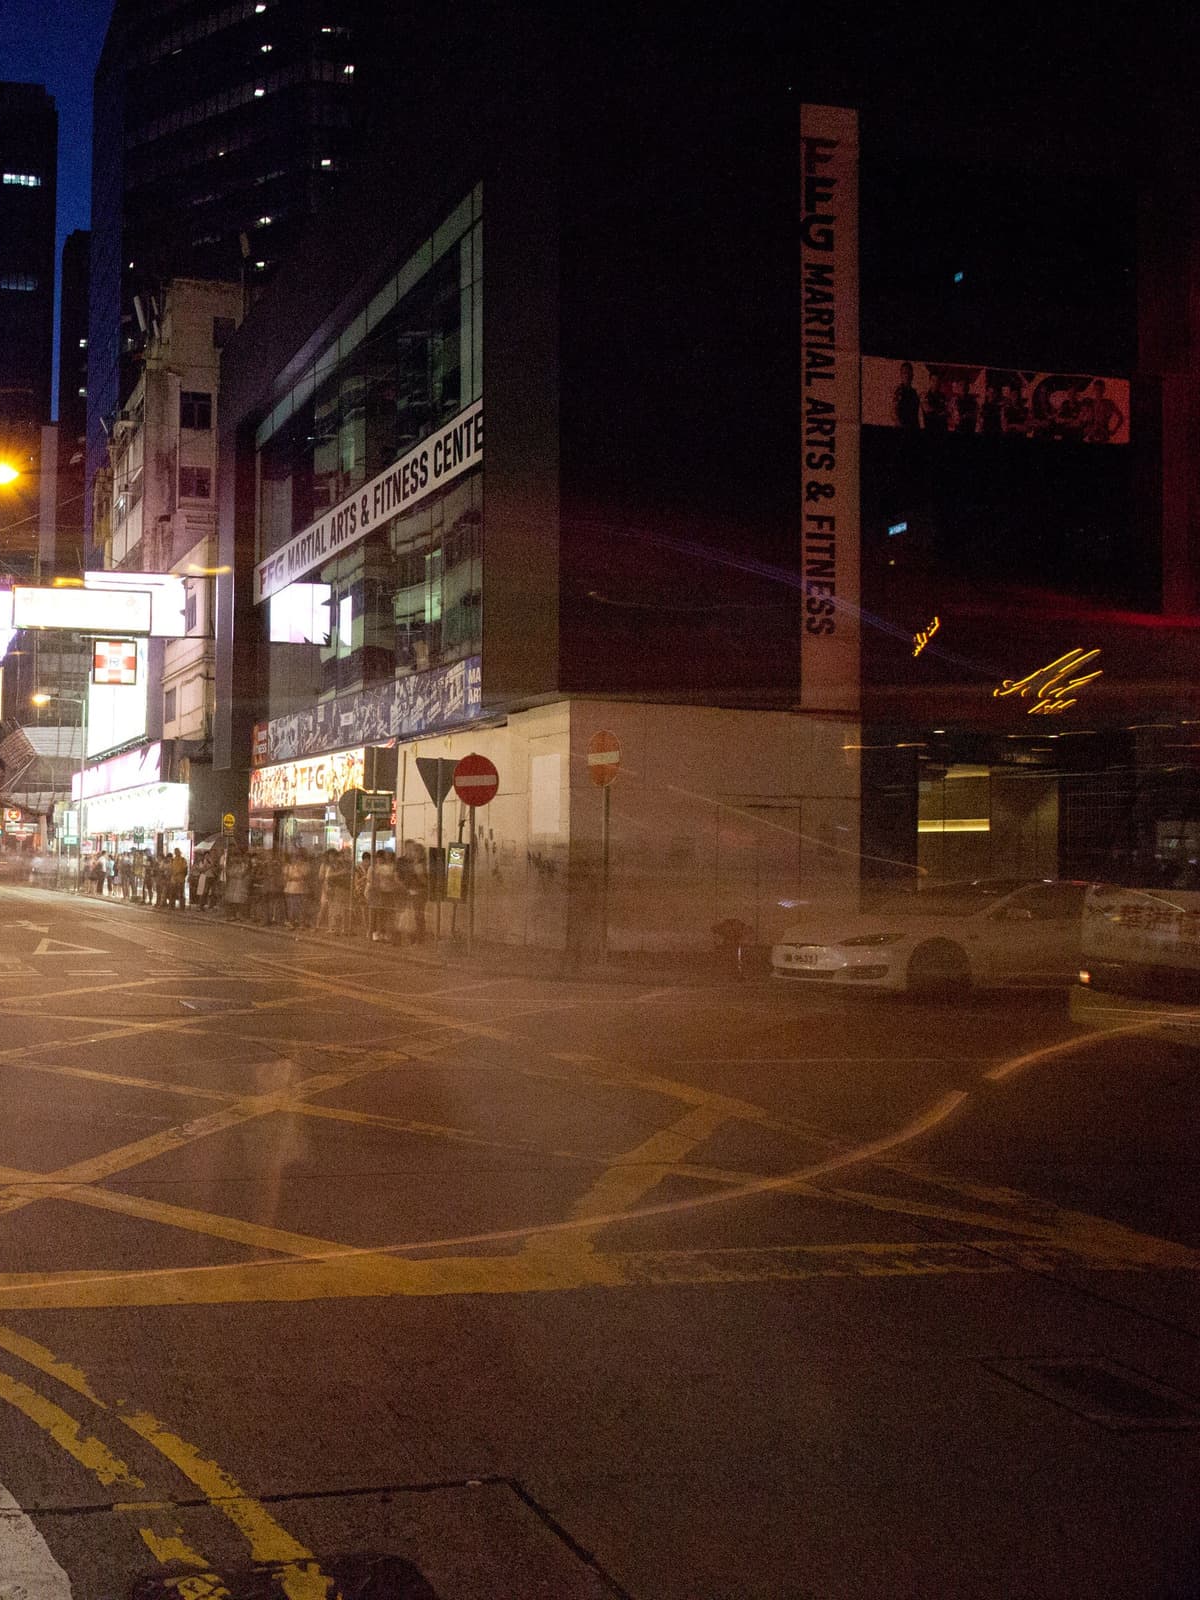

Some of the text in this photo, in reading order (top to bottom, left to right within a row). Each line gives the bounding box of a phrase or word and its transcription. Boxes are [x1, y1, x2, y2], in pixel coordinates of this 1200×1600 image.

[804, 262, 836, 387] MARTIAL
[805, 396, 836, 472] ARTS
[805, 480, 835, 504] &
[287, 524, 327, 576] MARTIAL
[329, 502, 357, 547] ARTS
[360, 494, 370, 528] &
[373, 450, 429, 519] FITNESS
[805, 514, 836, 636] FITNESS
